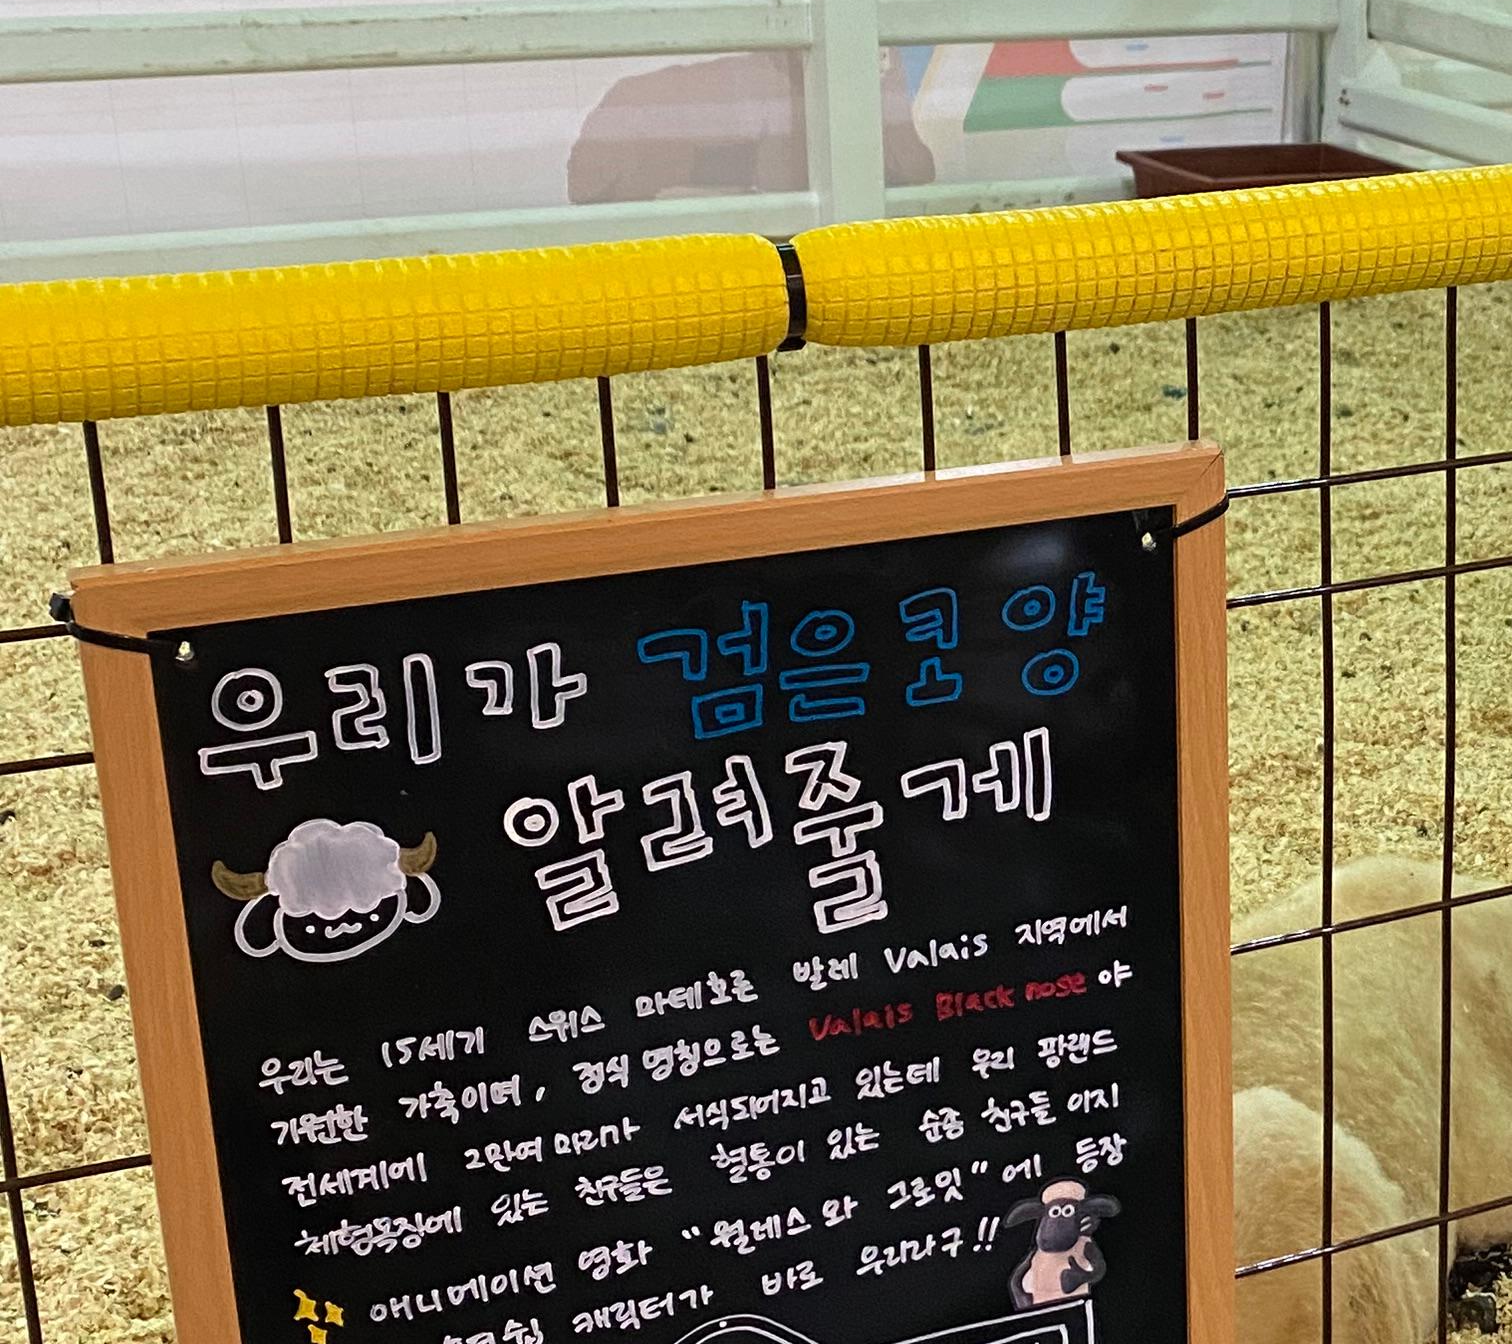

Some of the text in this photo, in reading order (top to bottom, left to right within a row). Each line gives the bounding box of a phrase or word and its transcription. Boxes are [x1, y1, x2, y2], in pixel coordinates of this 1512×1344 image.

[198, 641, 588, 792] 우리가
[503, 726, 1053, 933] 알려줄게
[259, 905, 1128, 1094] 우리는 15세기 스위스 마테호른 발레 Valais 지역에서
[271, 1105, 368, 1145] 기원한
[572, 1054, 629, 1094] 정식
[808, 1002, 914, 1041] Valais
[935, 984, 1015, 1022] Black
[282, 1153, 427, 1207] 전세계에
[855, 1057, 940, 1101] 있는데
[972, 1046, 1015, 1080] 우리
[491, 1189, 549, 1226] 있는
[574, 1165, 672, 1206] 친구들은
[711, 1142, 804, 1184] 혈통이
[827, 1122, 880, 1160] 있는
[919, 1107, 965, 1144] 순종
[369, 1260, 557, 1322] 애니메이션
[578, 1240, 654, 1280] 영화
[1075, 1133, 1128, 1173] 등장
[572, 1284, 714, 1334] 캐릭터가
[761, 1259, 824, 1297] 바로
